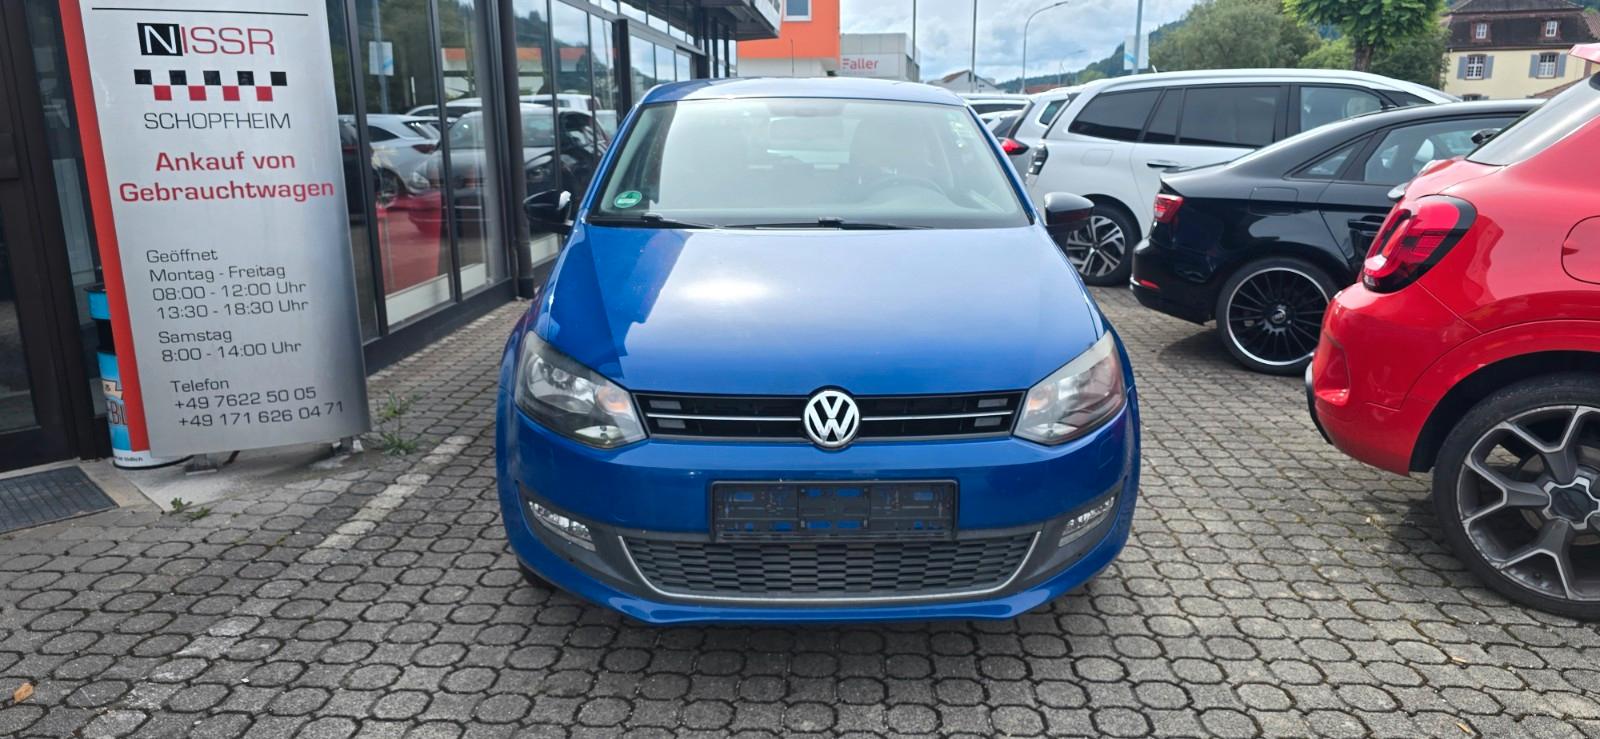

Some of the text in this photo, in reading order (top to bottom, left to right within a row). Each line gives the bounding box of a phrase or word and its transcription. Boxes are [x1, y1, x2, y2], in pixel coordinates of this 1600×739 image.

[142, 25, 275, 55] NISSR
[842, 58, 879, 70] Faller
[144, 112, 291, 130] SCHOPFHEIM
[156, 151, 296, 172] Ankauf von
[119, 181, 335, 202] Gebrauchtwagen
[146, 249, 218, 263] Geöffnet
[149, 268, 215, 283] Montag
[229, 265, 286, 279] Freitag
[152, 286, 206, 301] 08:00
[221, 283, 271, 298] 12:00
[276, 281, 307, 294] Uhr
[157, 305, 208, 320] 13:30
[224, 301, 274, 316] 18:30
[278, 299, 309, 312] Uhr
[158, 329, 232, 344] Samstag
[161, 348, 202, 362] 8:00
[218, 344, 267, 359] 14:00
[272, 341, 302, 354] Uhr
[170, 378, 230, 393] Telefon
[175, 386, 317, 410] +49 7622 50 05
[179, 401, 344, 427] +49 171 626 04 71
[806, 392, 858, 446] VW
